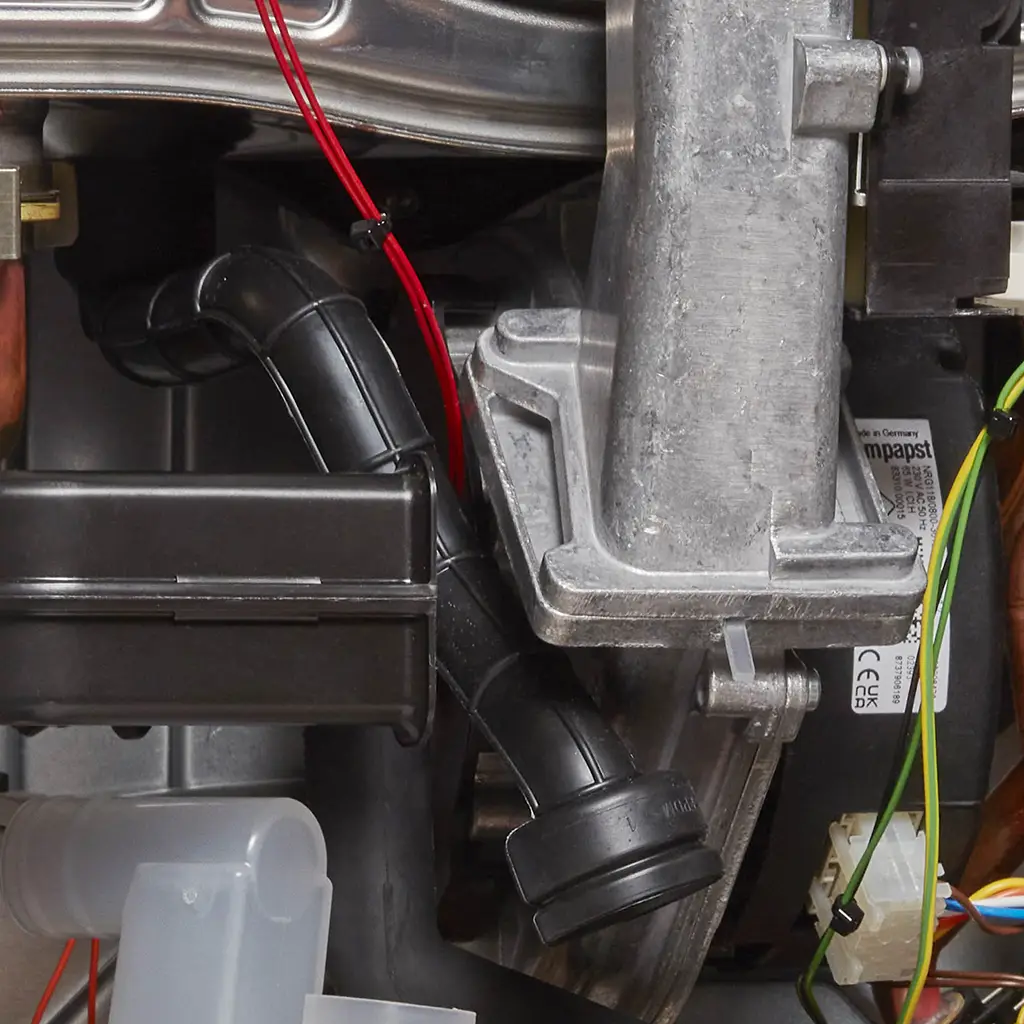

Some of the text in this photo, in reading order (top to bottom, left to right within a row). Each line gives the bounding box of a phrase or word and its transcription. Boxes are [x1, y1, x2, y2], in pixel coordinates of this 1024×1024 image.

[882, 428, 919, 438] Germany
[864, 440, 932, 463] mpapst
[918, 506, 926, 517] 50
[857, 649, 880, 681] CE
[855, 685, 866, 708] CA
[867, 685, 878, 707] UK
